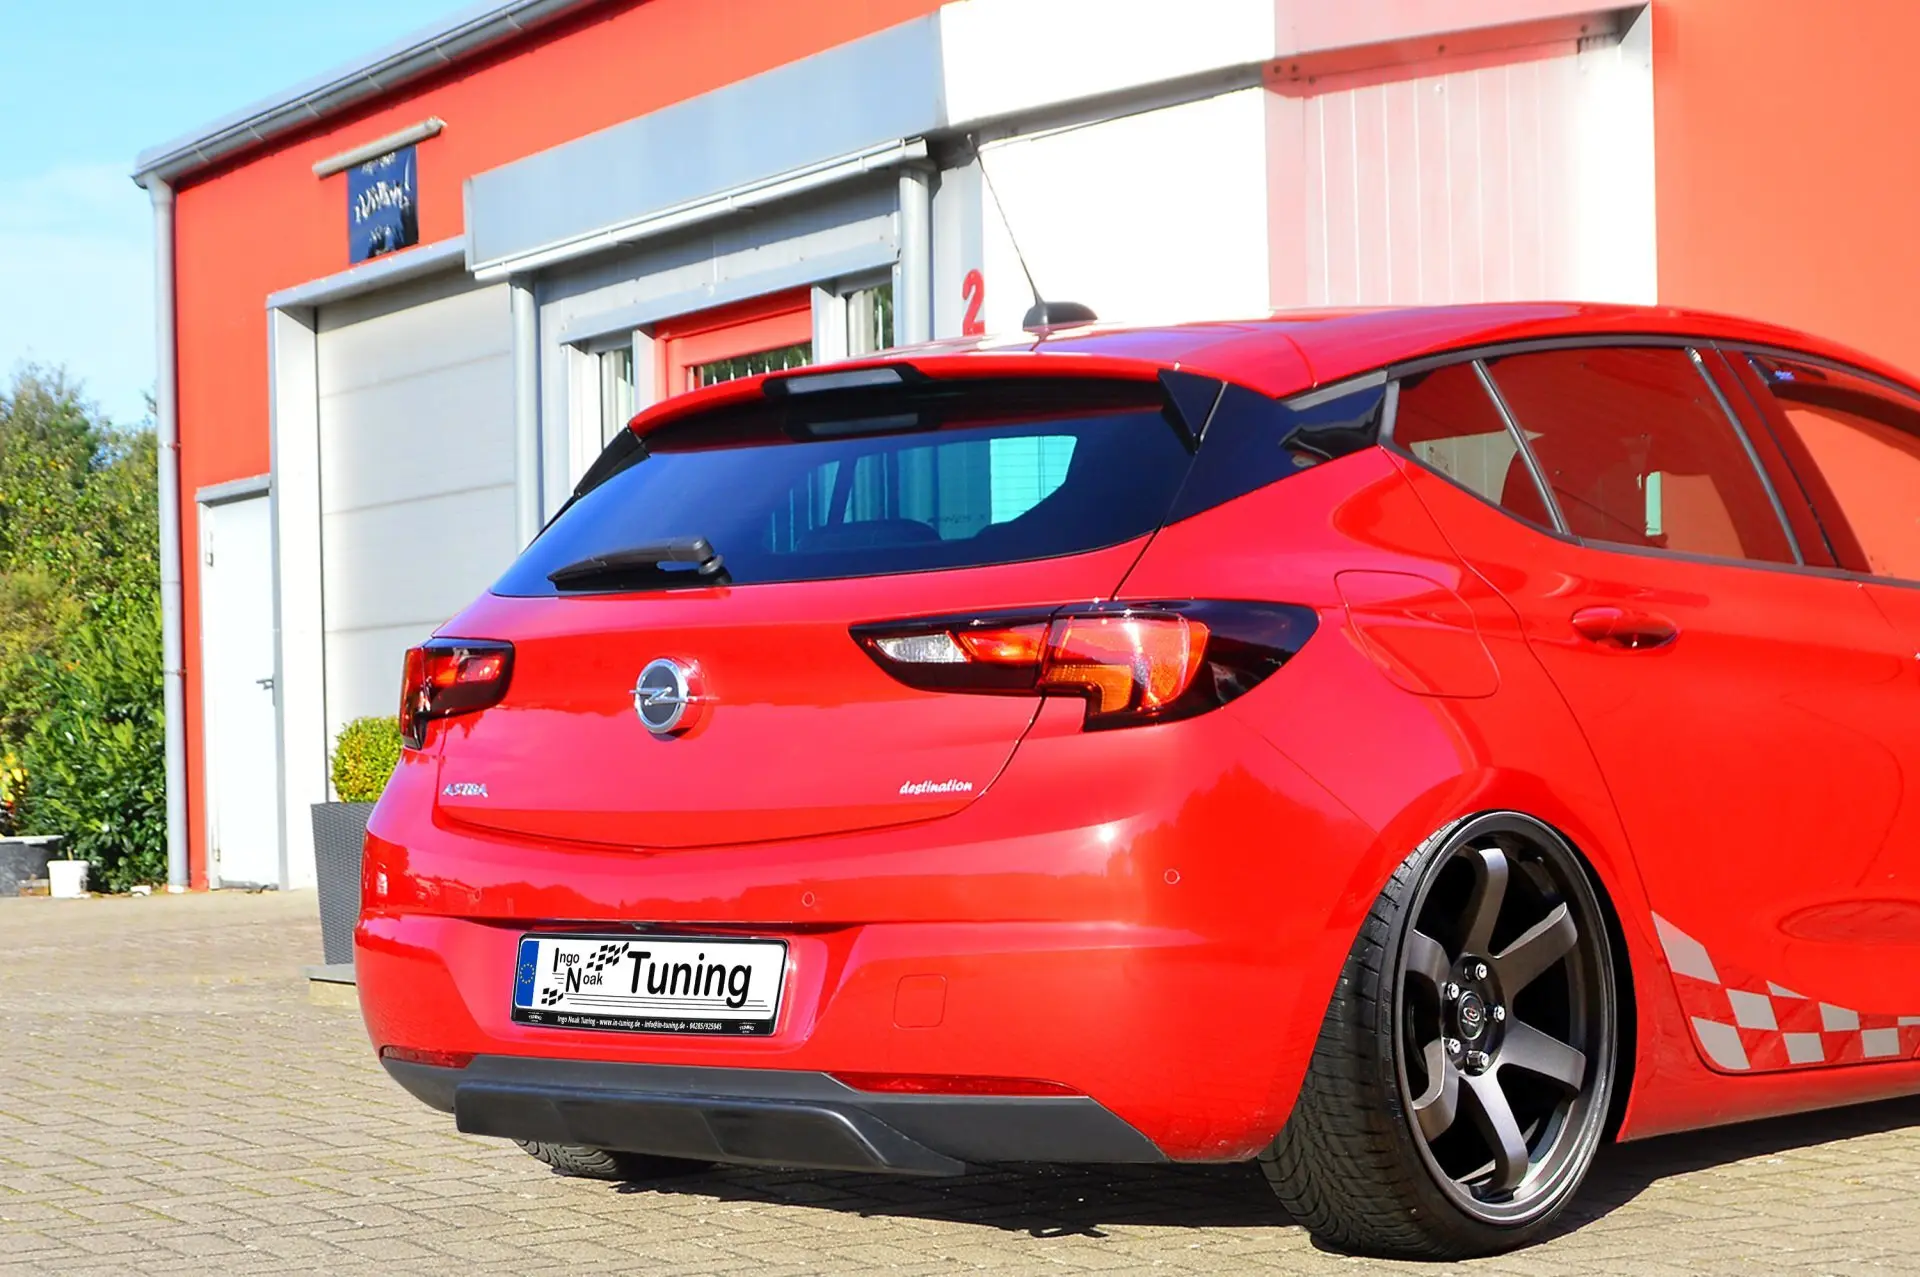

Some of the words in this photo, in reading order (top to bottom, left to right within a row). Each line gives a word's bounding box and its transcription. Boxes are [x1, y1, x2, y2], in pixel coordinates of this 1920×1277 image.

[962, 268, 985, 337] 2
[899, 780, 973, 794] destination
[553, 947, 580, 972] Ingo
[565, 967, 603, 993] Noak
[627, 951, 752, 1008] Tuning
